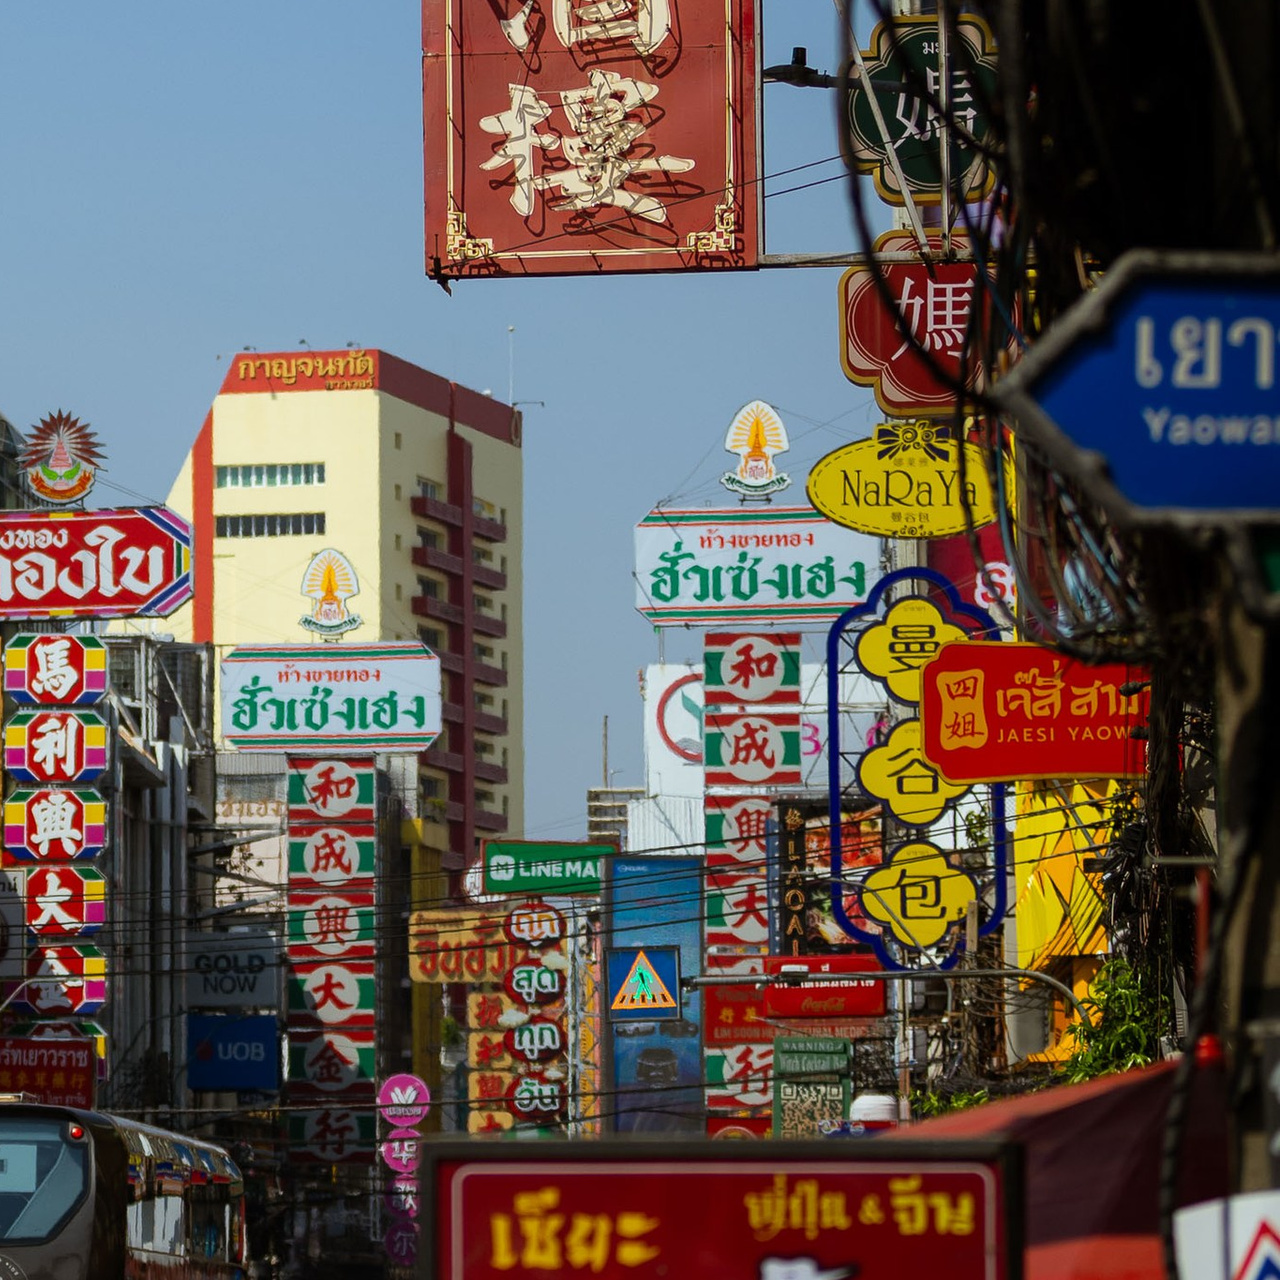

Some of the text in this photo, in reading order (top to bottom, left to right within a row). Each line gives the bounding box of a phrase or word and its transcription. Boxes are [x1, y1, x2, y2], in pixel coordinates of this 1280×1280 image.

[1135, 315, 1280, 389] เยา
[1142, 407, 1280, 445] Yaowa
[840, 469, 979, 508] NaRaYa
[699, 526, 815, 550] ห้างขายทอง
[649, 541, 867, 603] ฮั่วเซ่งเฮง
[276, 663, 381, 684] ห้างขายทอง
[230, 675, 426, 733] ฮั่วเซ่งเฮง
[996, 726, 1132, 743] JAESI YAOW
[29, 639, 83, 1038] 馬利興大金
[726, 643, 779, 1097] 和成興大行
[195, 953, 266, 975] GOLD
[202, 975, 258, 995] NOW
[217, 1040, 266, 1063] UOB
